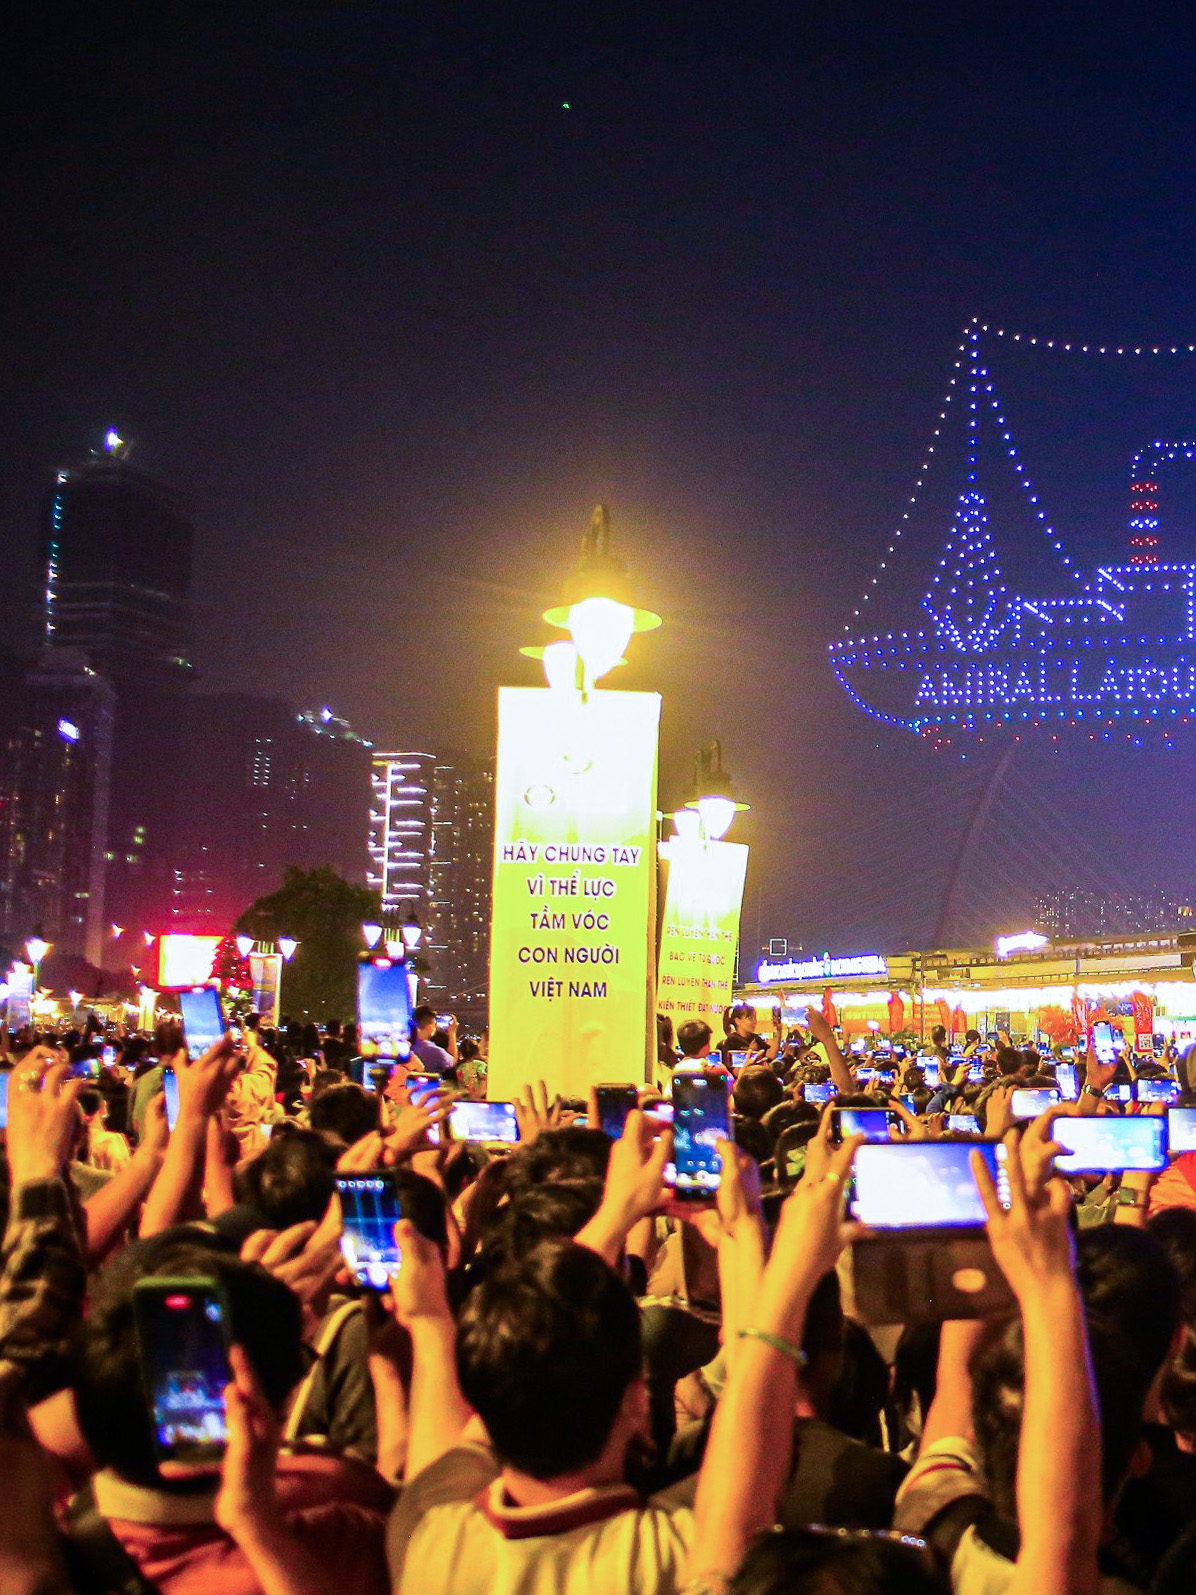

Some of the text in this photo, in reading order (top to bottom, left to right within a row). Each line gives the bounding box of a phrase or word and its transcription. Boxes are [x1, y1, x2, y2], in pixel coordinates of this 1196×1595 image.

[914, 669, 1063, 705] AMIRAL
[503, 841, 639, 863] HÃY CHUNG TAY
[527, 870, 615, 901] VÌ THỂ LỰC
[530, 905, 609, 930] TẦM VÓC
[518, 944, 619, 964] CON NGƯỜI
[529, 976, 607, 1002] VIỆT NAM
